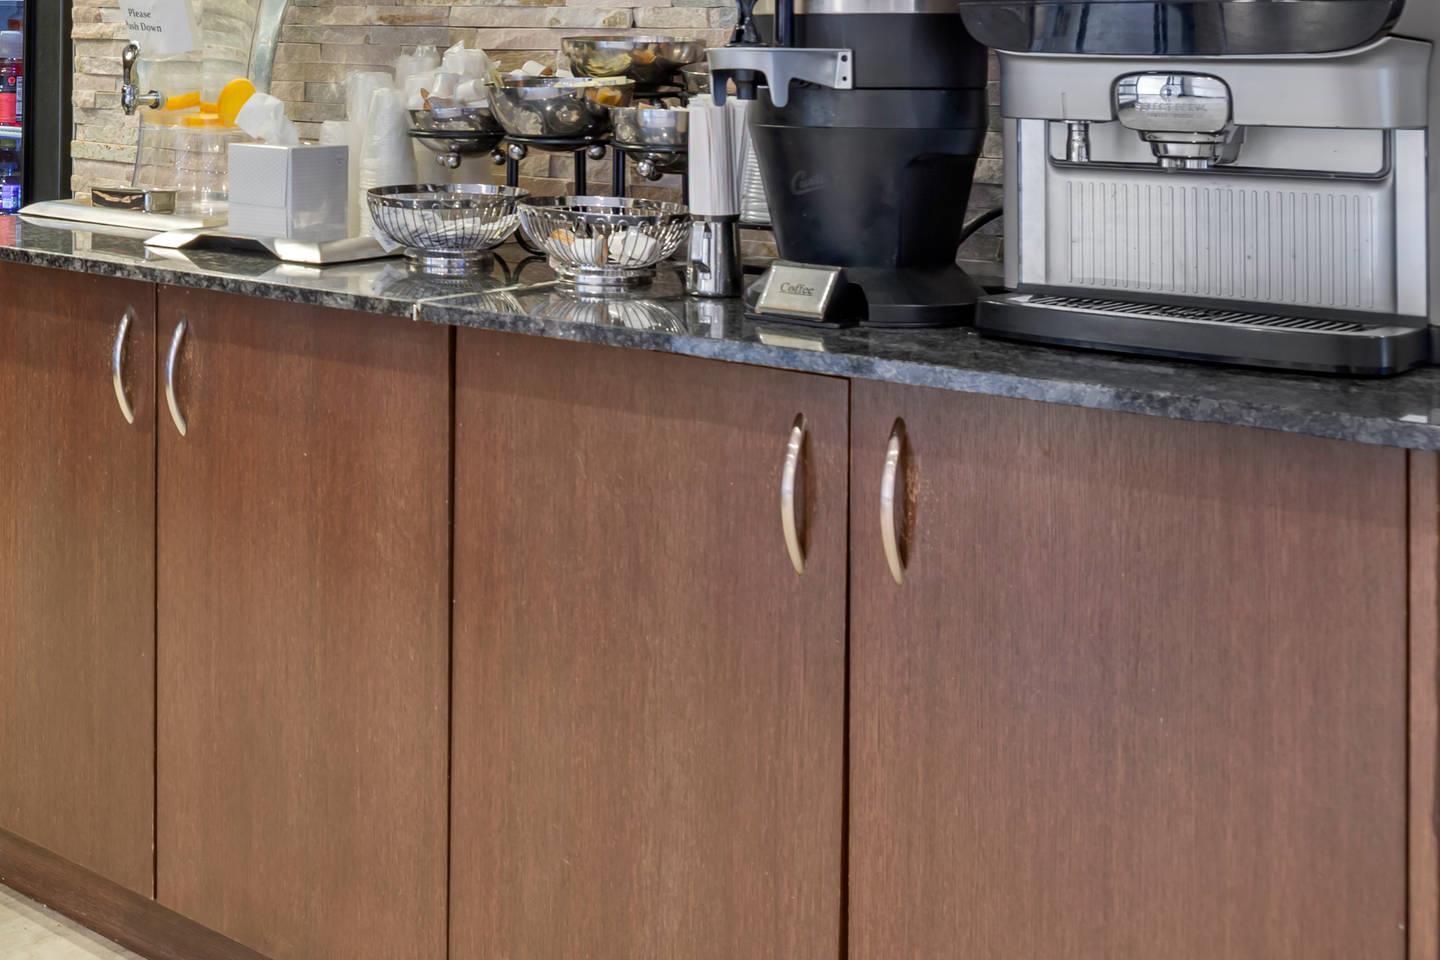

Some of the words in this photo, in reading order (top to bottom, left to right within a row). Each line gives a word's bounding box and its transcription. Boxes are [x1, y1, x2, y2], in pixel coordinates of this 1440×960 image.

[128, 8, 152, 18] Please
[140, 22, 163, 32] Down
[780, 281, 815, 296] Coffee
